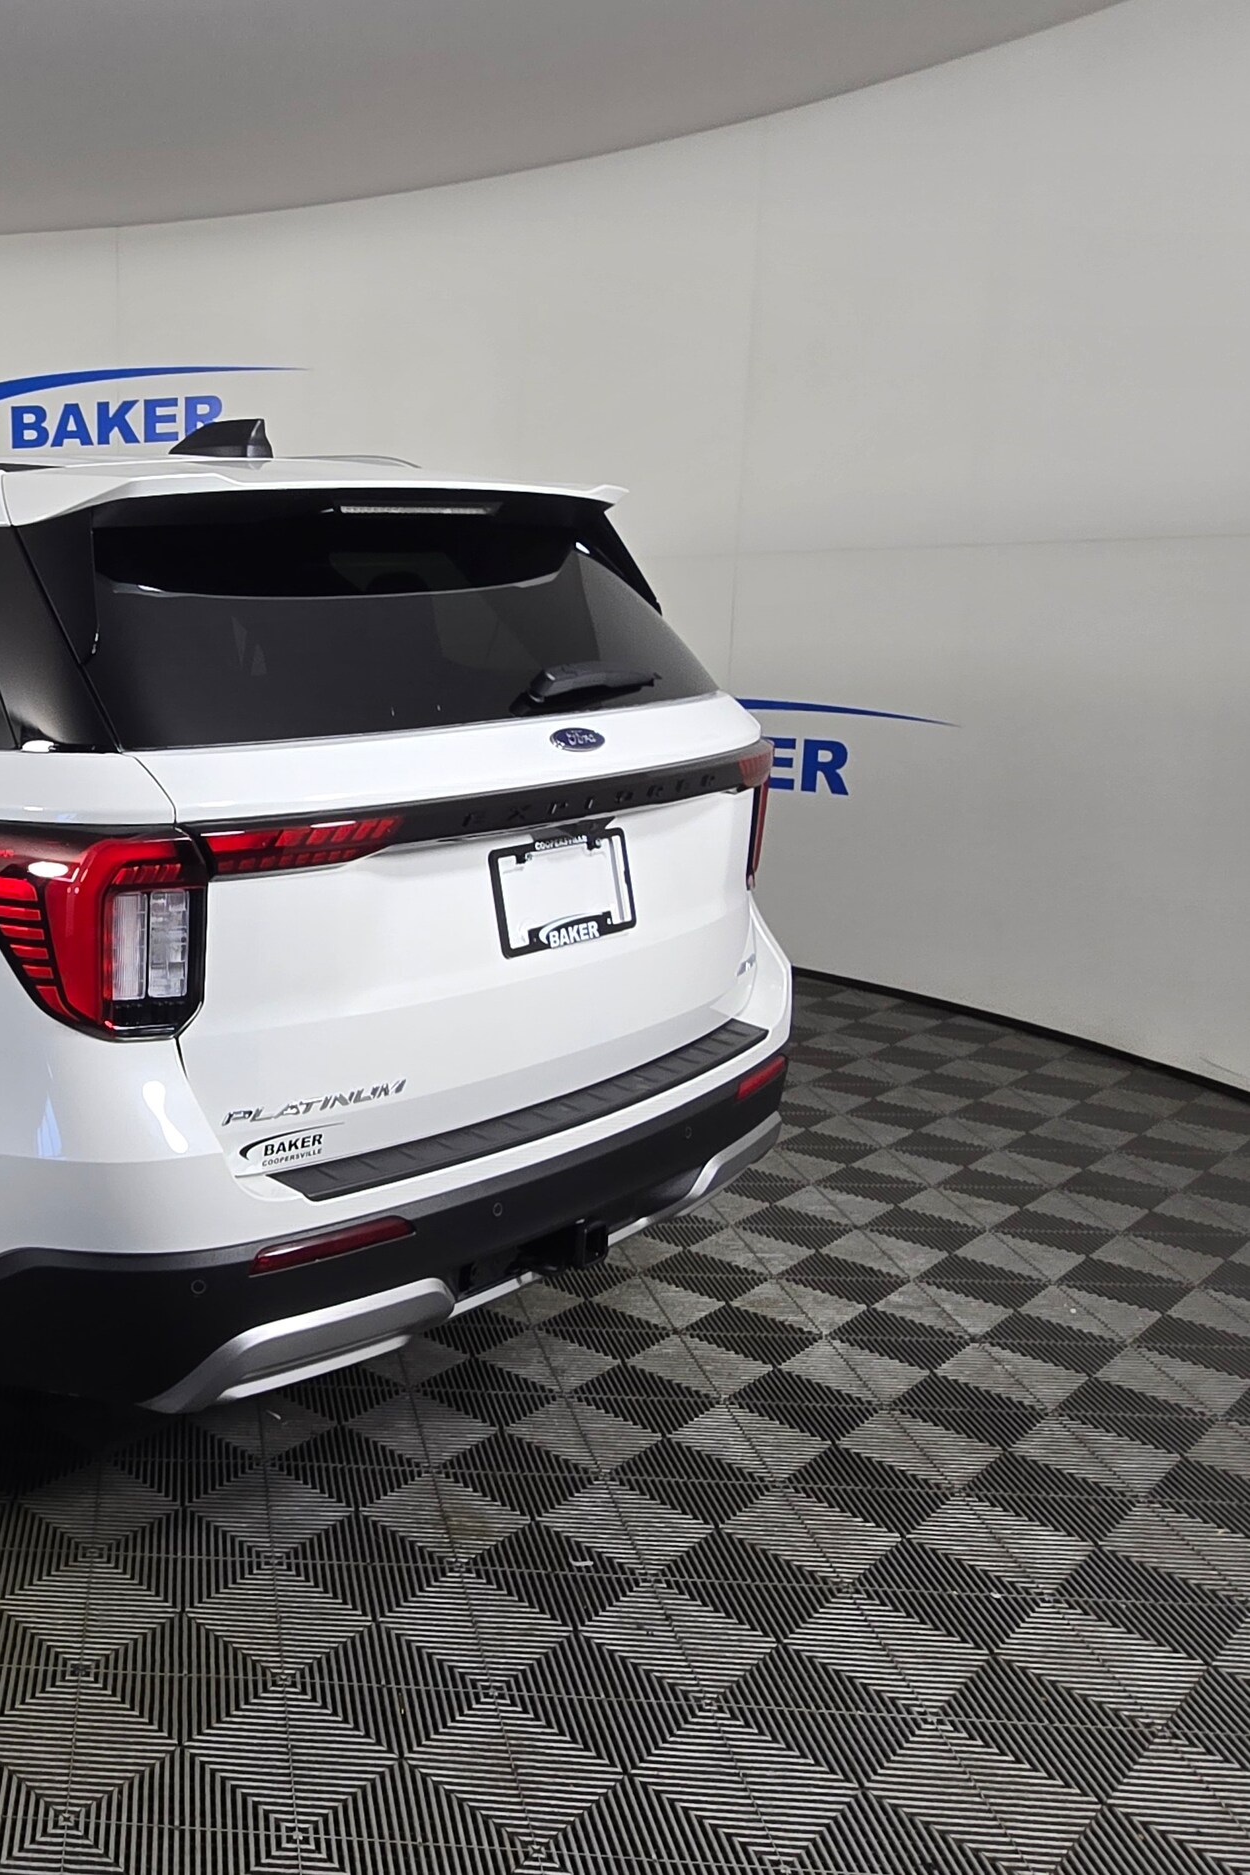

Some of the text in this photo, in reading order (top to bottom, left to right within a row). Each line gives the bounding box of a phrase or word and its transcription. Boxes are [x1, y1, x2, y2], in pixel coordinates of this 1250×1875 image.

[11, 395, 222, 449] BAKER
[549, 920, 600, 948] BAKER
[221, 1078, 406, 1126] PLATINUM
[262, 1148, 323, 1167] COOPERSVILLE
[264, 1134, 323, 1157] BAKER
